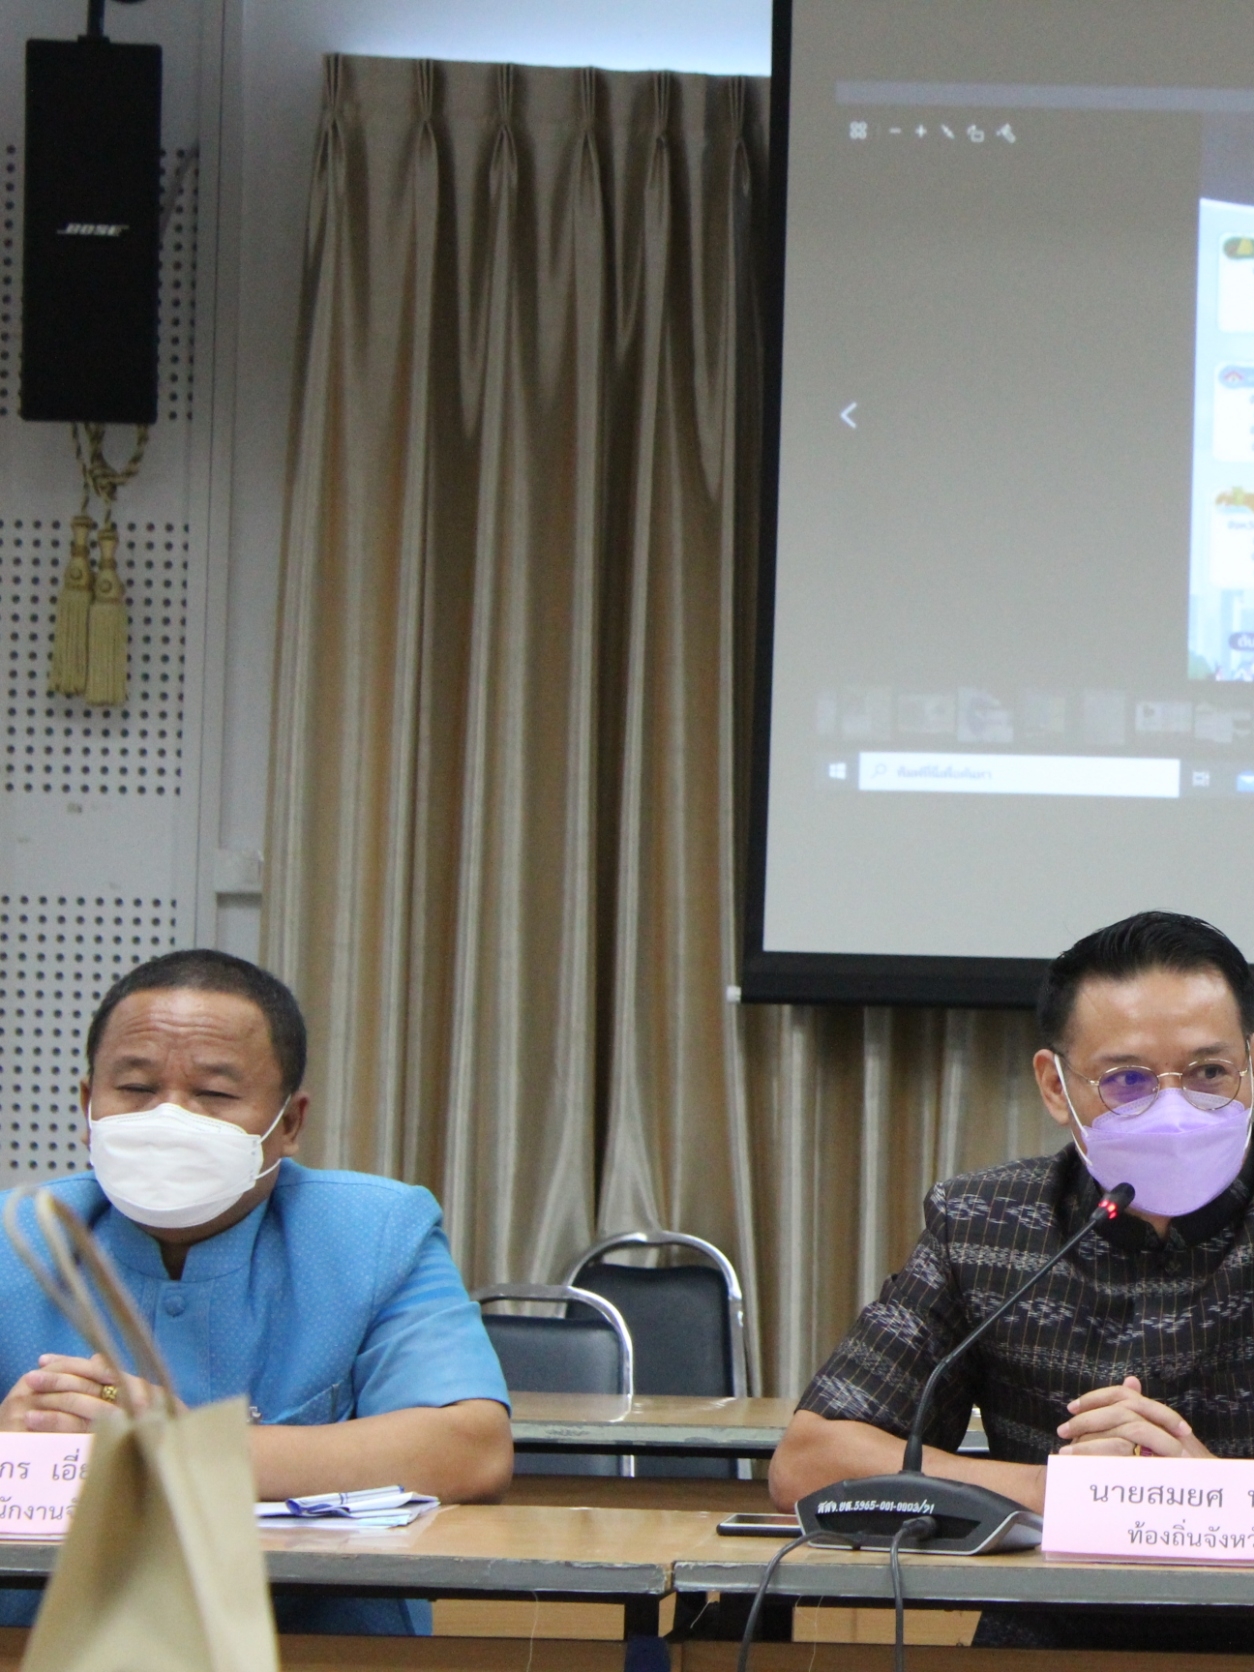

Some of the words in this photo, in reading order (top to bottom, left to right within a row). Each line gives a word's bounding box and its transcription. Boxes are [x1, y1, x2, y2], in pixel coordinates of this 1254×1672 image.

[57, 222, 130, 237] BOSE
[1090, 1482, 1224, 1508] นายสมยศ
